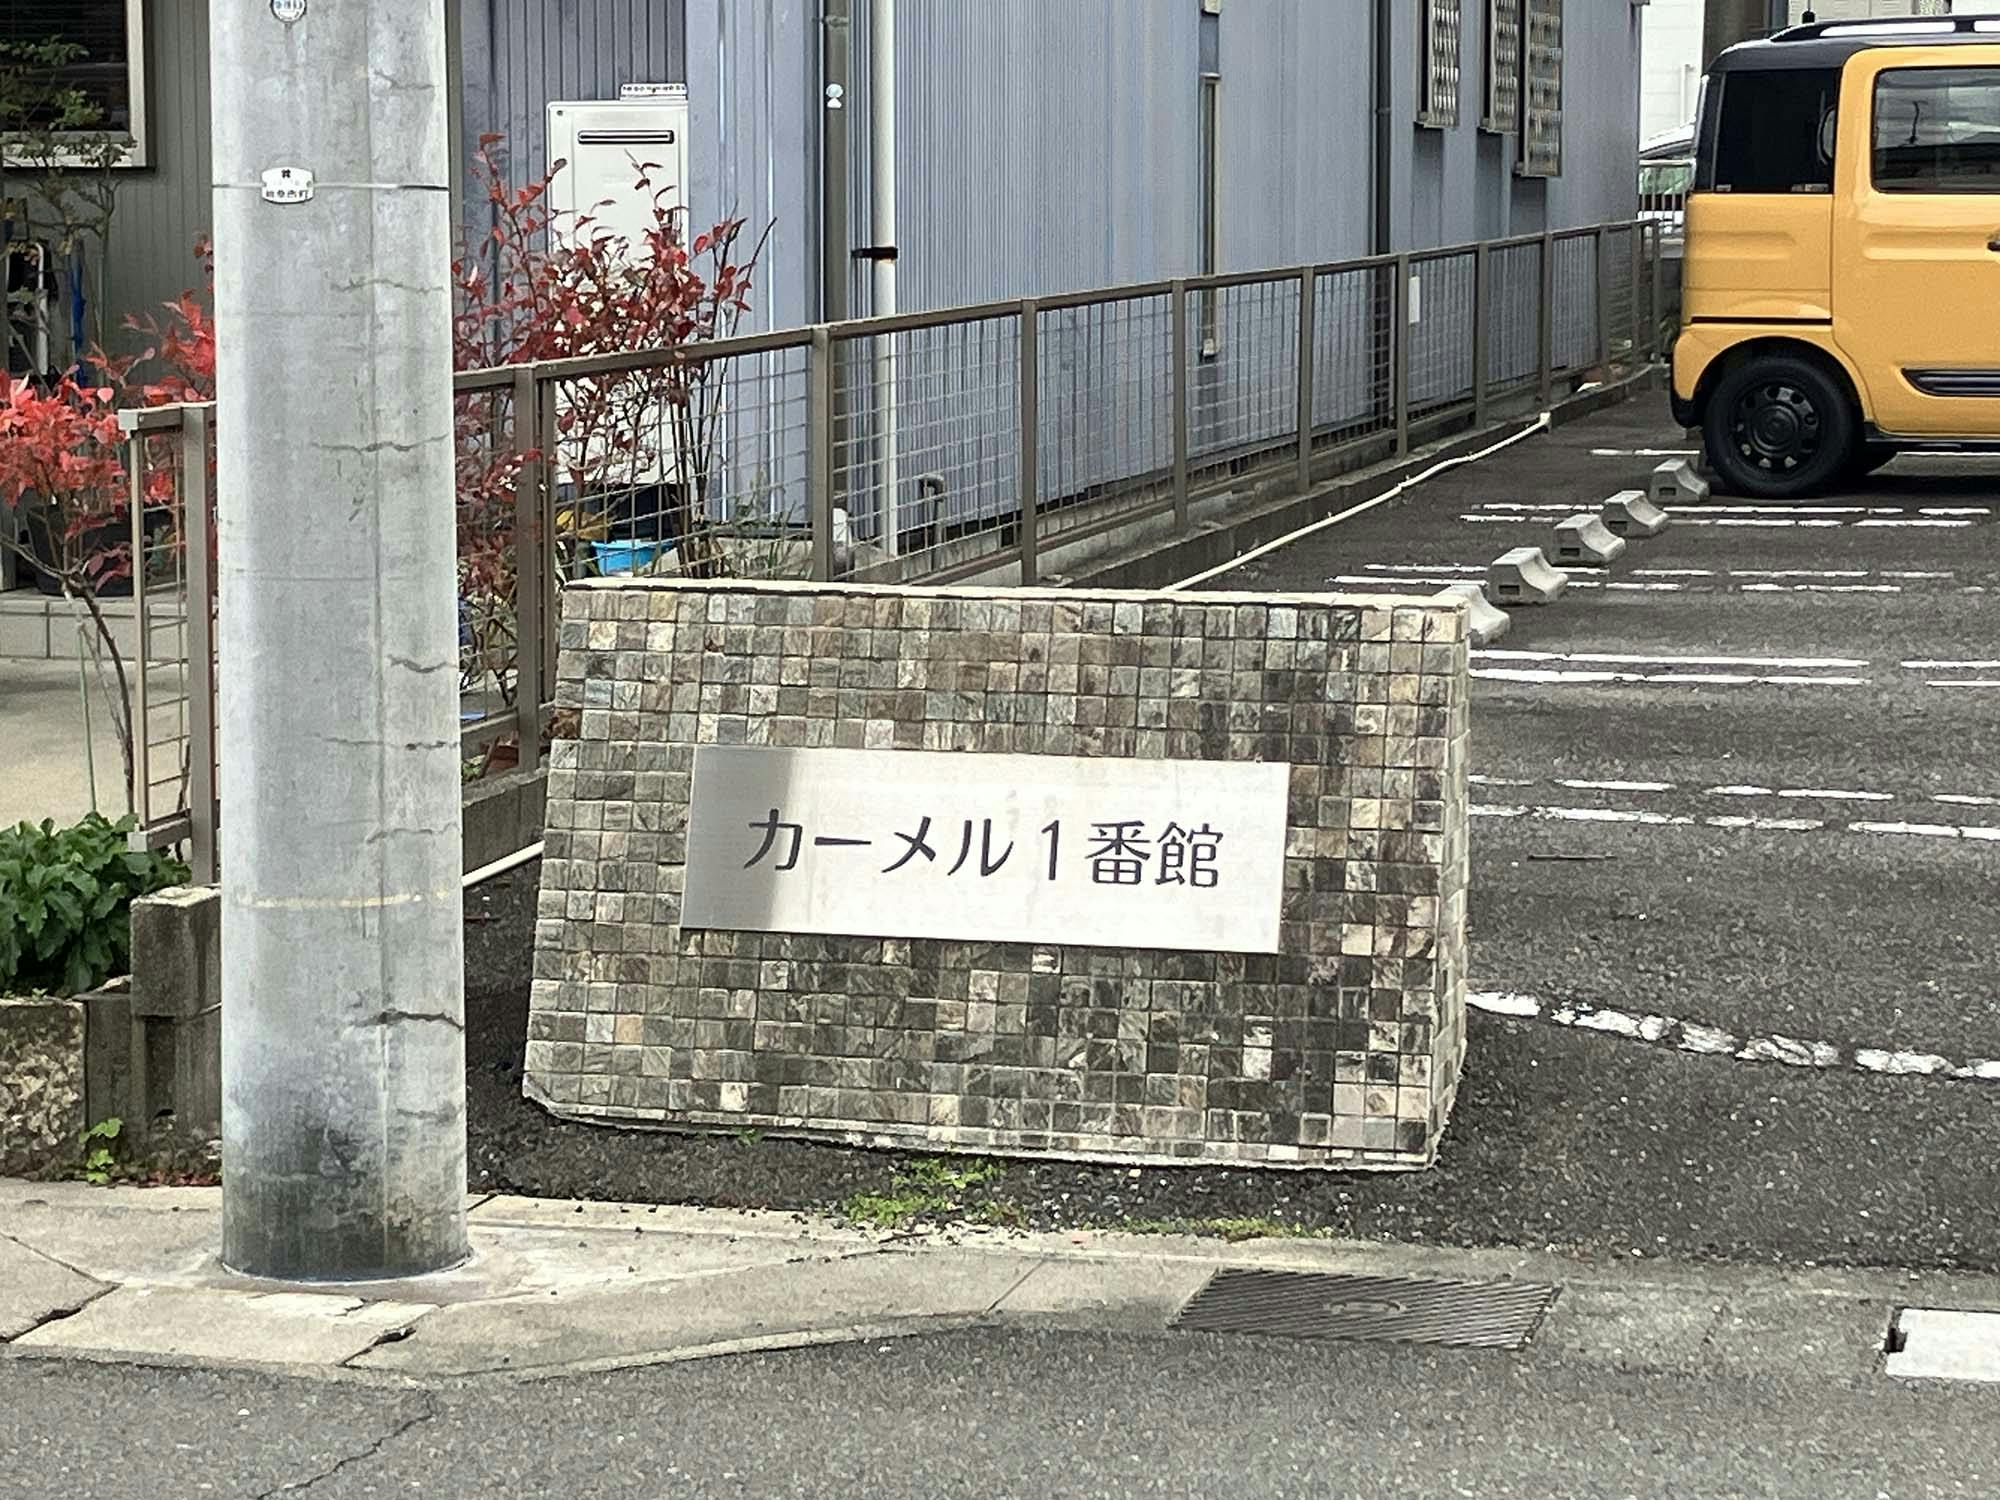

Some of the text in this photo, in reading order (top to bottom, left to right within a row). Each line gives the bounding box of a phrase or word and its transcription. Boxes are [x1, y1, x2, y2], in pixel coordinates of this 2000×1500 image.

[743, 808, 1224, 888] カーメル1番館
